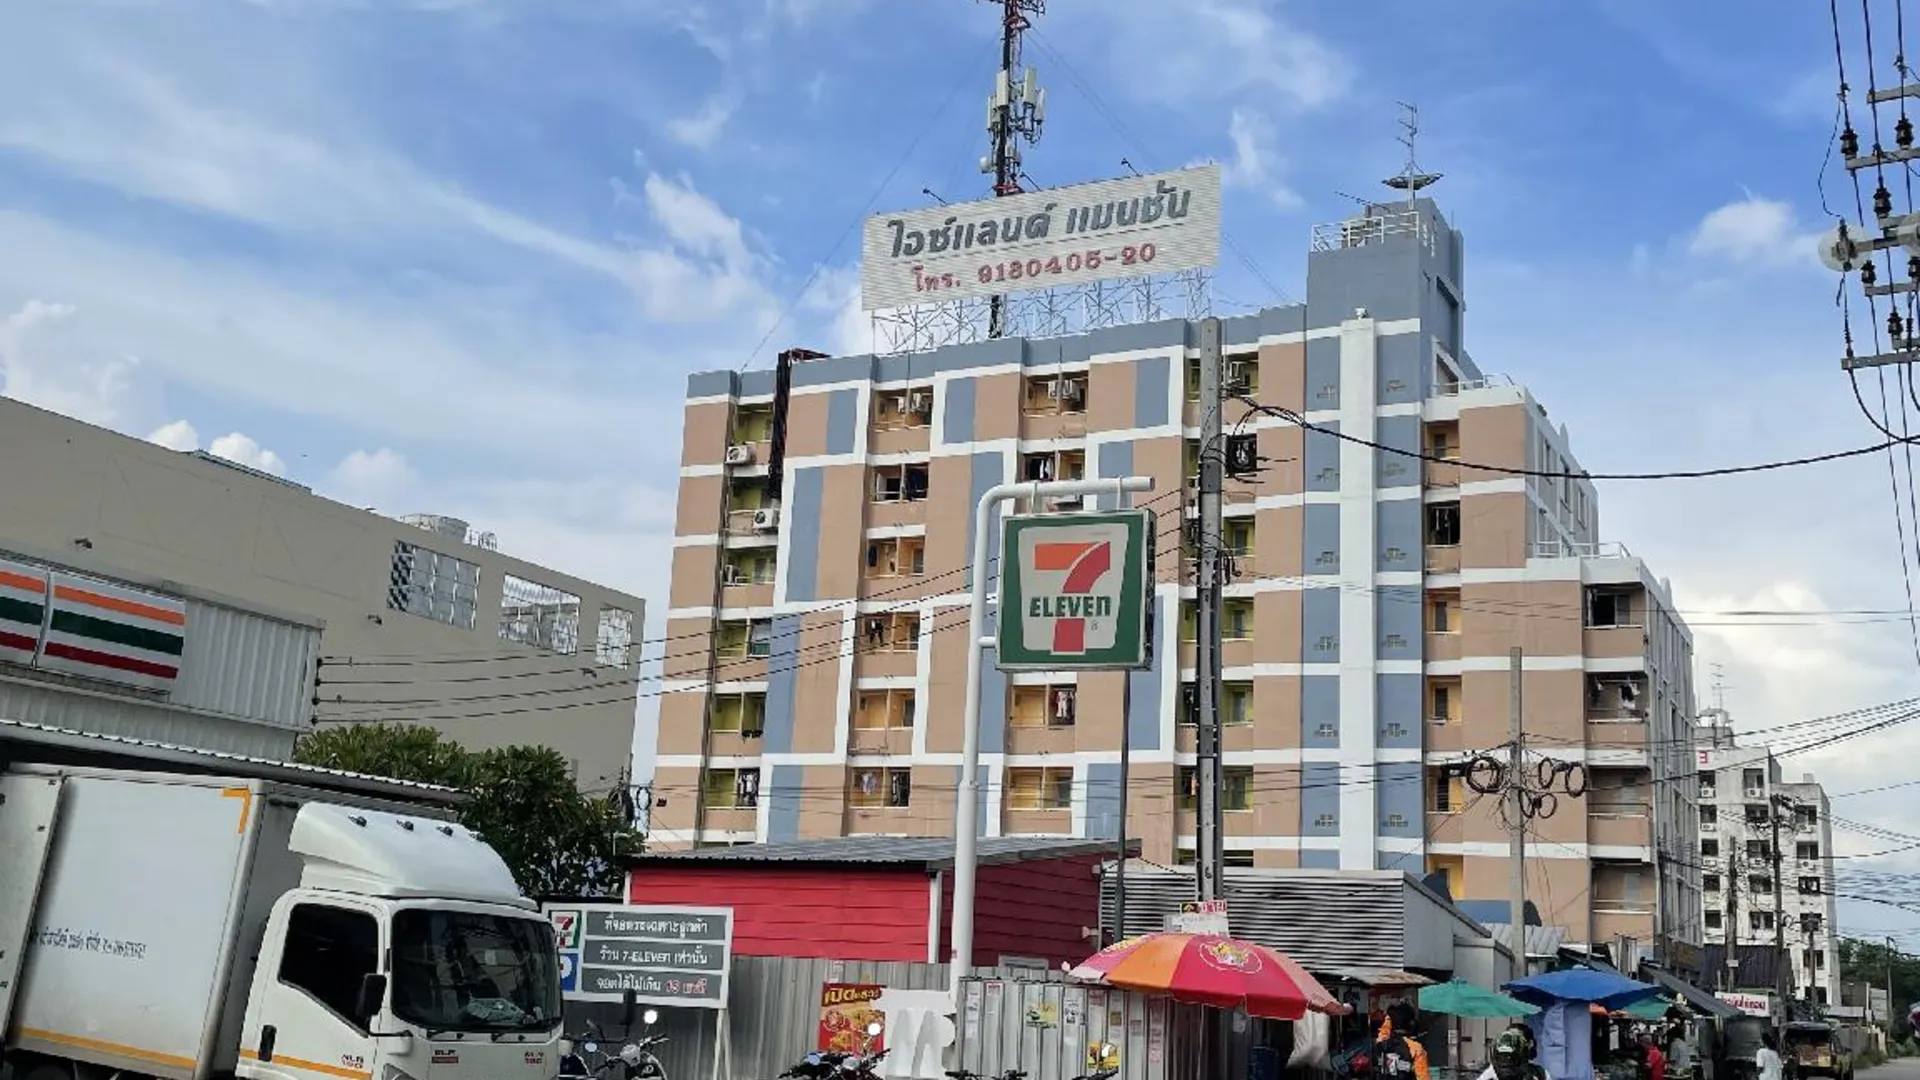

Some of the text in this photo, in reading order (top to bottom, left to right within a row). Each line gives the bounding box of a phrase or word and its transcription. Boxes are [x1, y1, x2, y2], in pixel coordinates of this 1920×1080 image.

[887, 201, 1058, 259] ไอซ์แลนด์
[911, 242, 1157, 292] โทร. 9180405-20
